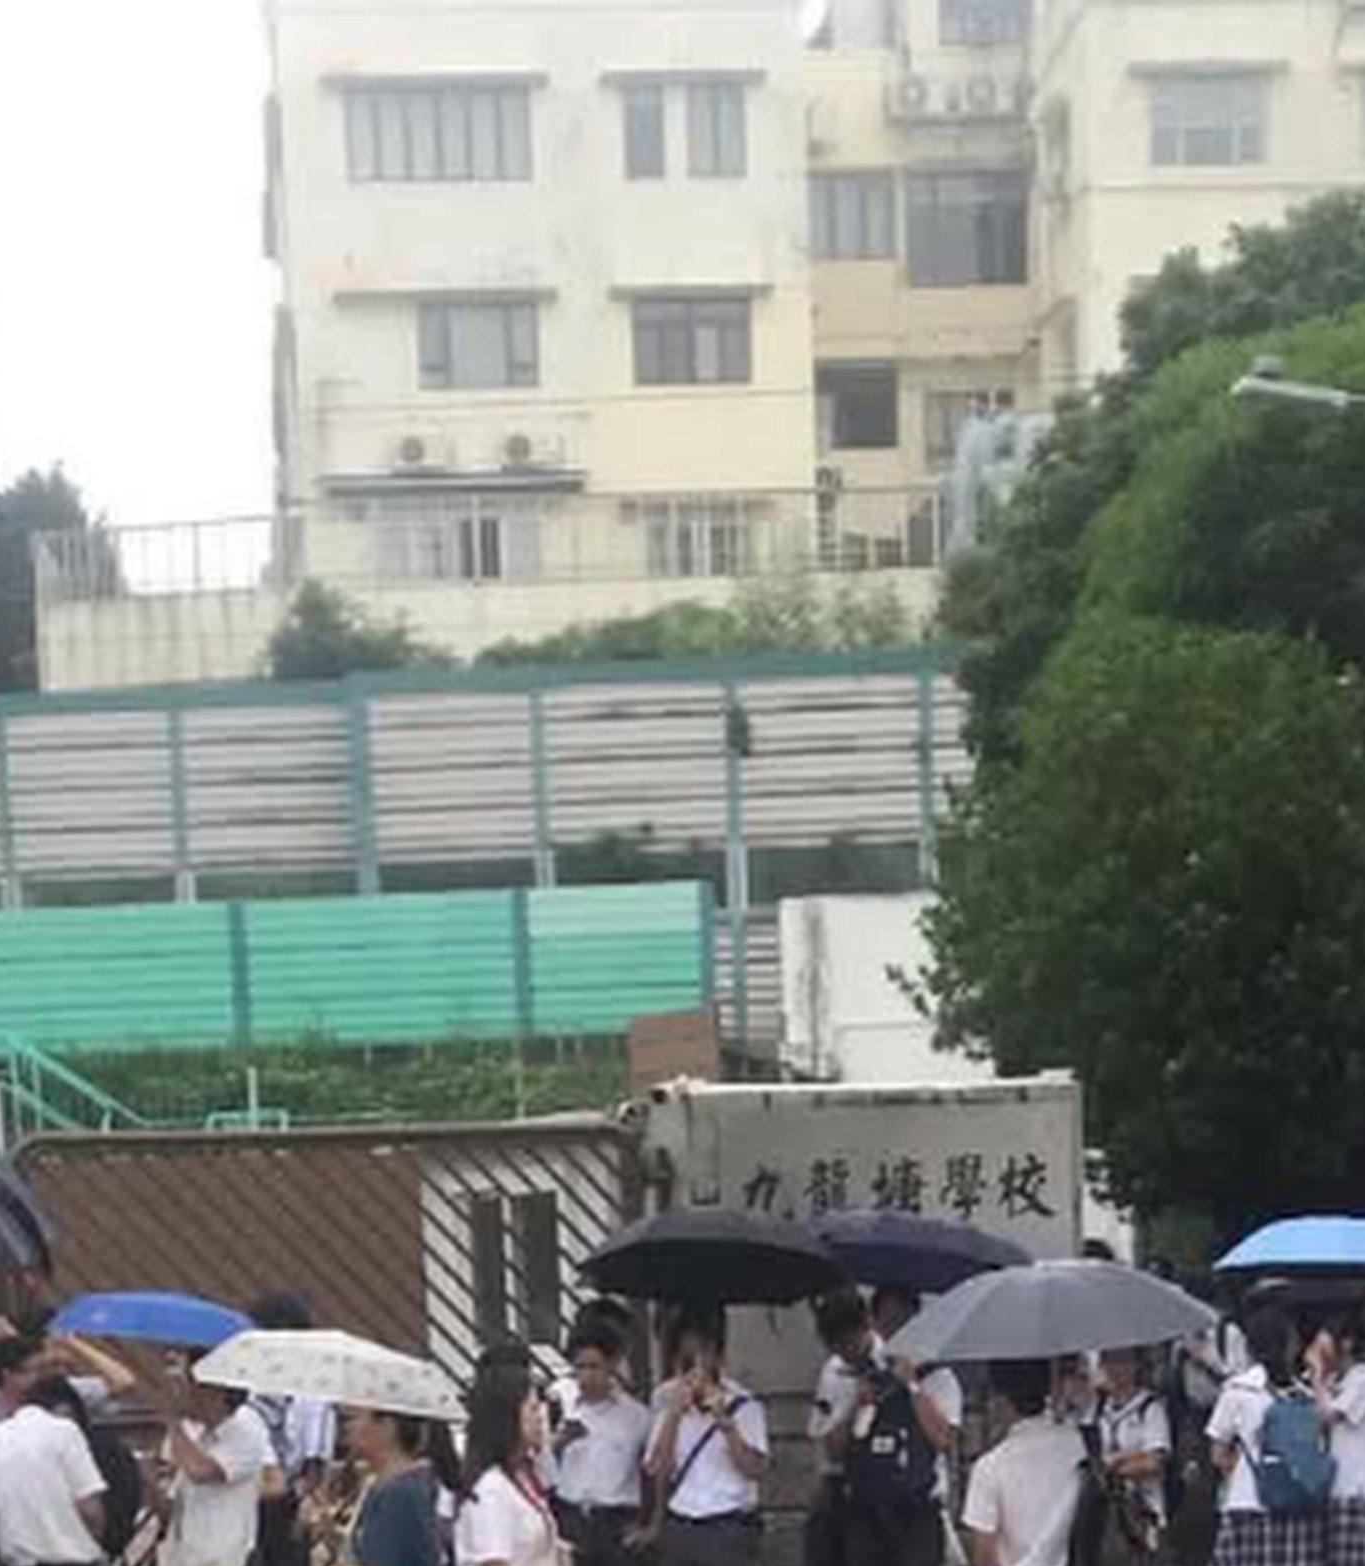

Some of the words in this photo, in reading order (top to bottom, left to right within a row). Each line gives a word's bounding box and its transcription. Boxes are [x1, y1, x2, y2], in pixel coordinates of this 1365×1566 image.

[743, 1151, 1056, 1221] 九龍塘學校
